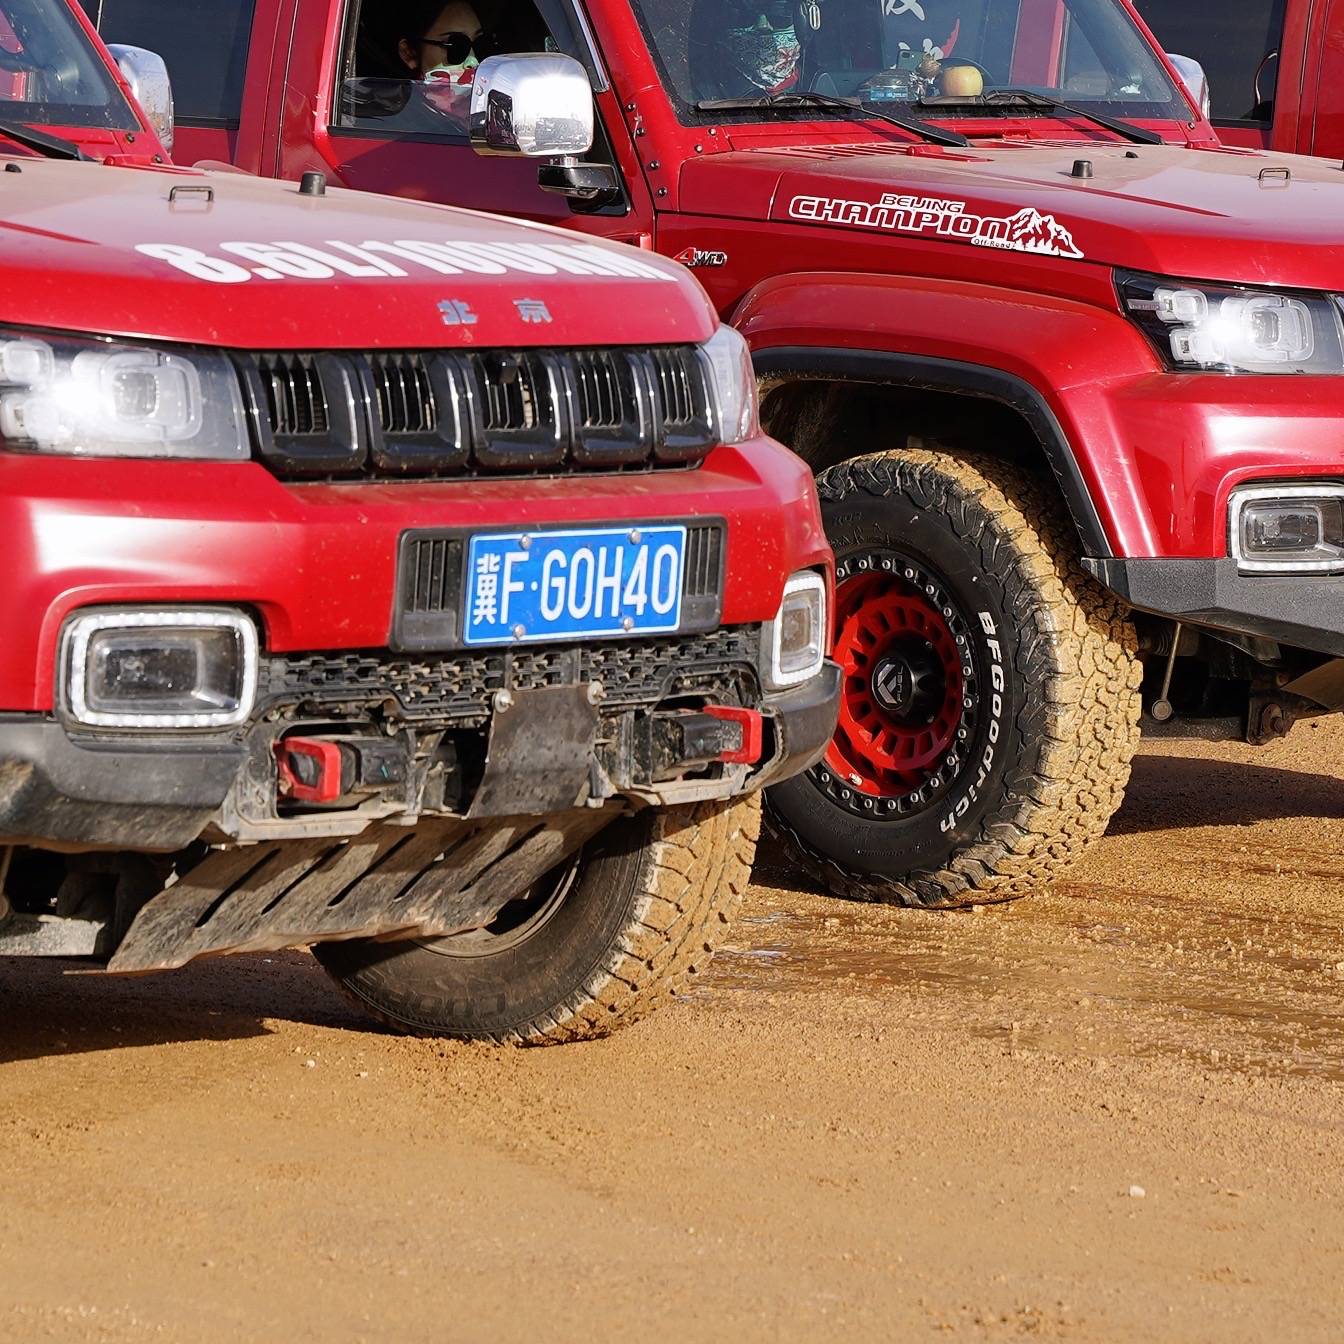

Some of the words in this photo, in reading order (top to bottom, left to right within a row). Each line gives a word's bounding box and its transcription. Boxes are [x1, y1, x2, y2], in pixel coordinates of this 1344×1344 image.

[880, 193, 966, 214] BEIJING
[673, 247, 728, 266] 4WD
[436, 297, 553, 325] 北京
